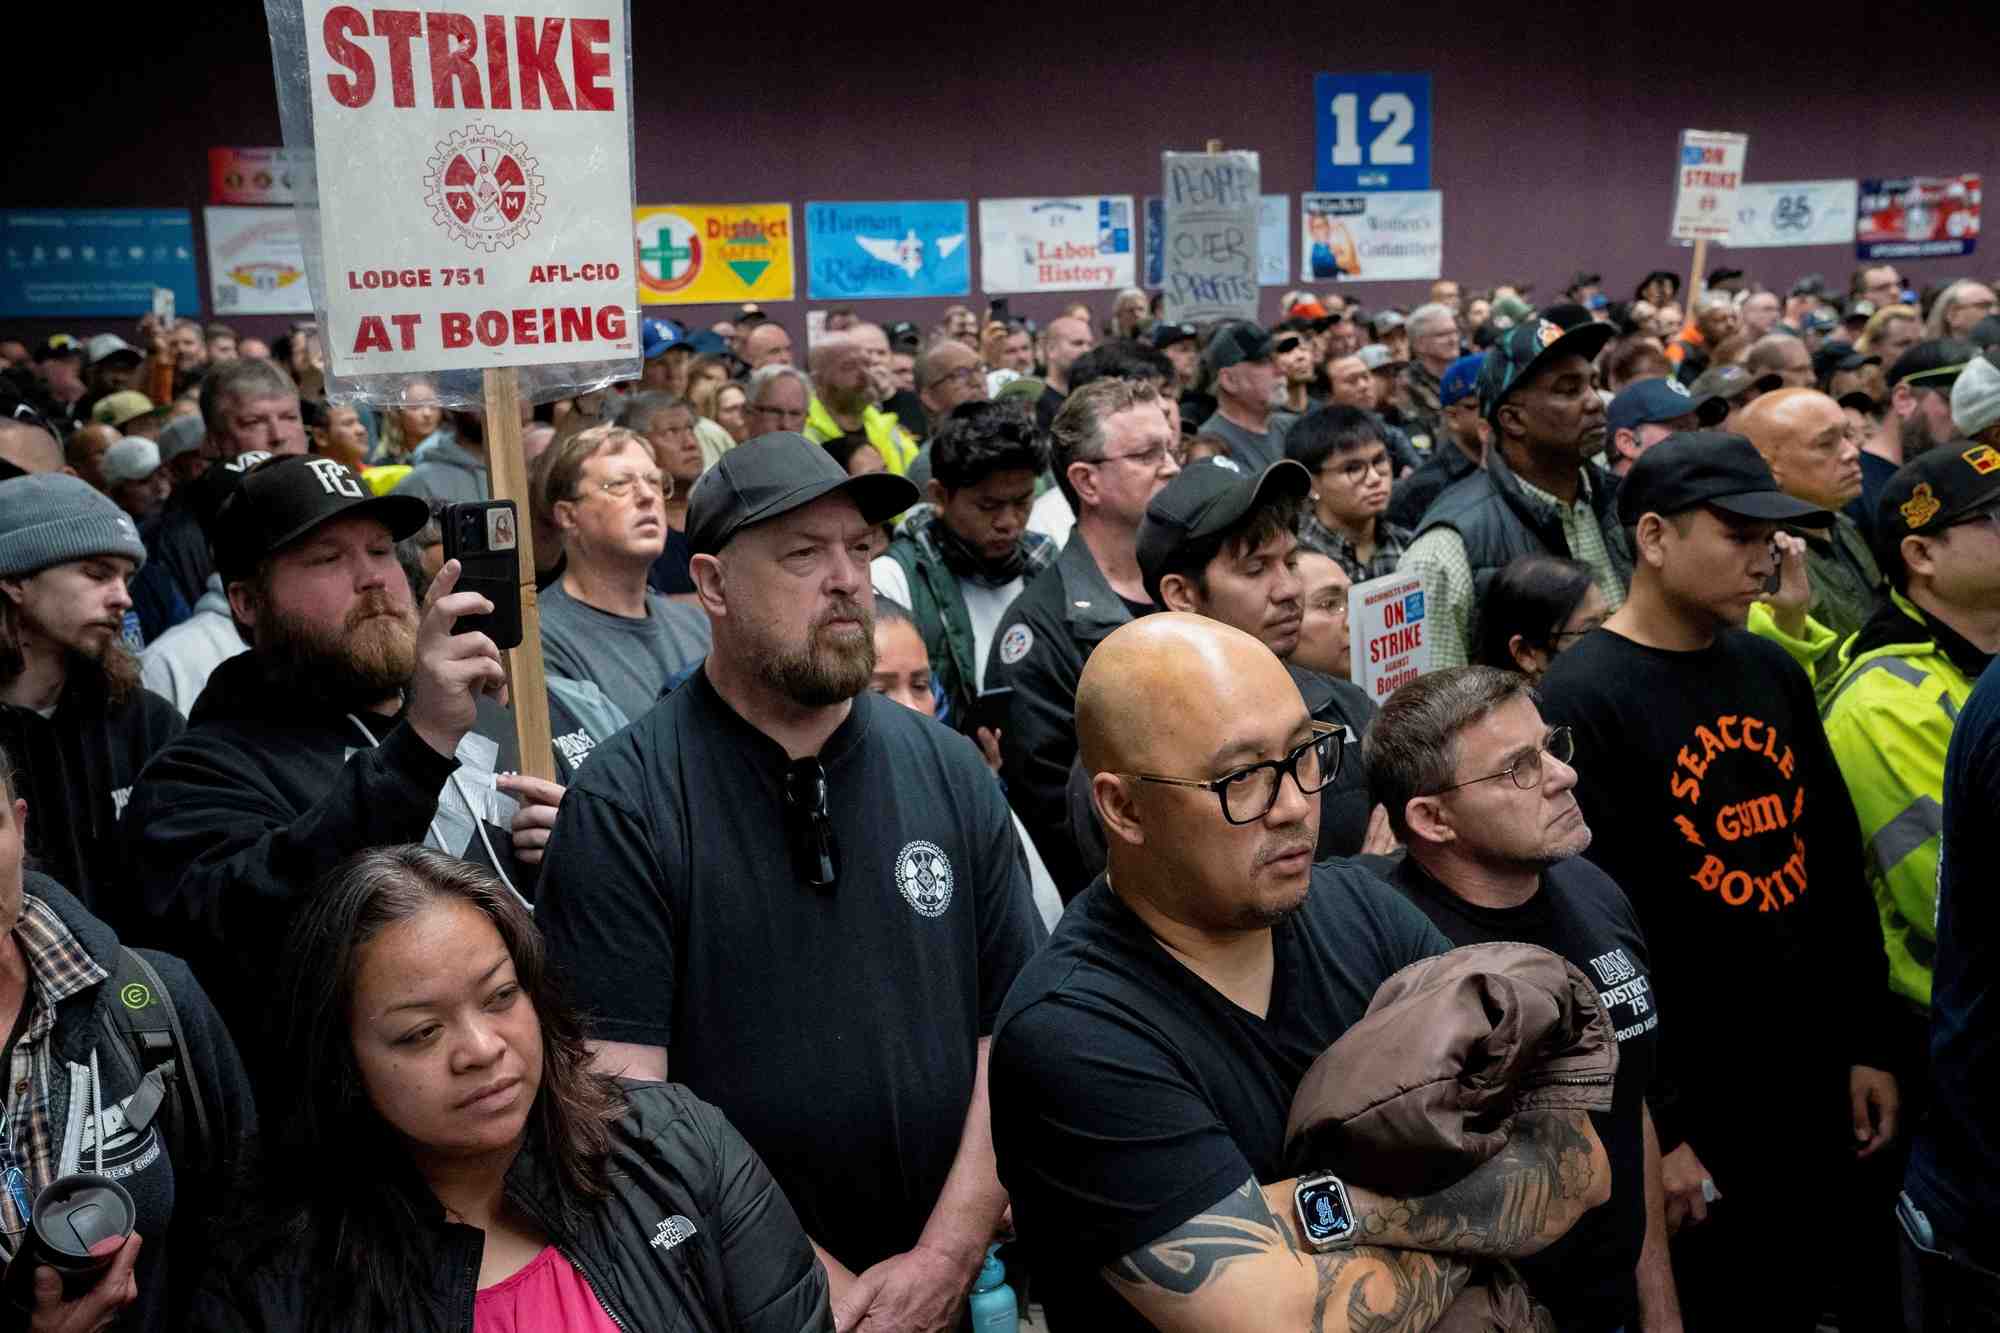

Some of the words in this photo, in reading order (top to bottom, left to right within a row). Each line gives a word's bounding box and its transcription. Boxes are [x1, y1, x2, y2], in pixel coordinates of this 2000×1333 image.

[322, 5, 615, 111] STRIKE
[1331, 92, 1415, 166] 12
[455, 197, 468, 210] A
[506, 196, 519, 209] M
[706, 217, 788, 240] District
[816, 208, 902, 234] Human
[1037, 239, 1098, 260] Labor
[348, 268, 432, 289] LODGE
[440, 267, 485, 286] 751
[529, 263, 620, 283] AFL-CIO
[1039, 265, 1116, 286] History
[352, 313, 422, 353] AT
[440, 305, 627, 349] BOEING
[1384, 600, 1404, 629] ON
[1370, 624, 1421, 663] STRIKE
[1690, 832, 1807, 912] BOXIN
[650, 1223, 680, 1248] NORTH
[656, 1217, 675, 1231] THE
[663, 1232, 686, 1250] FACE
